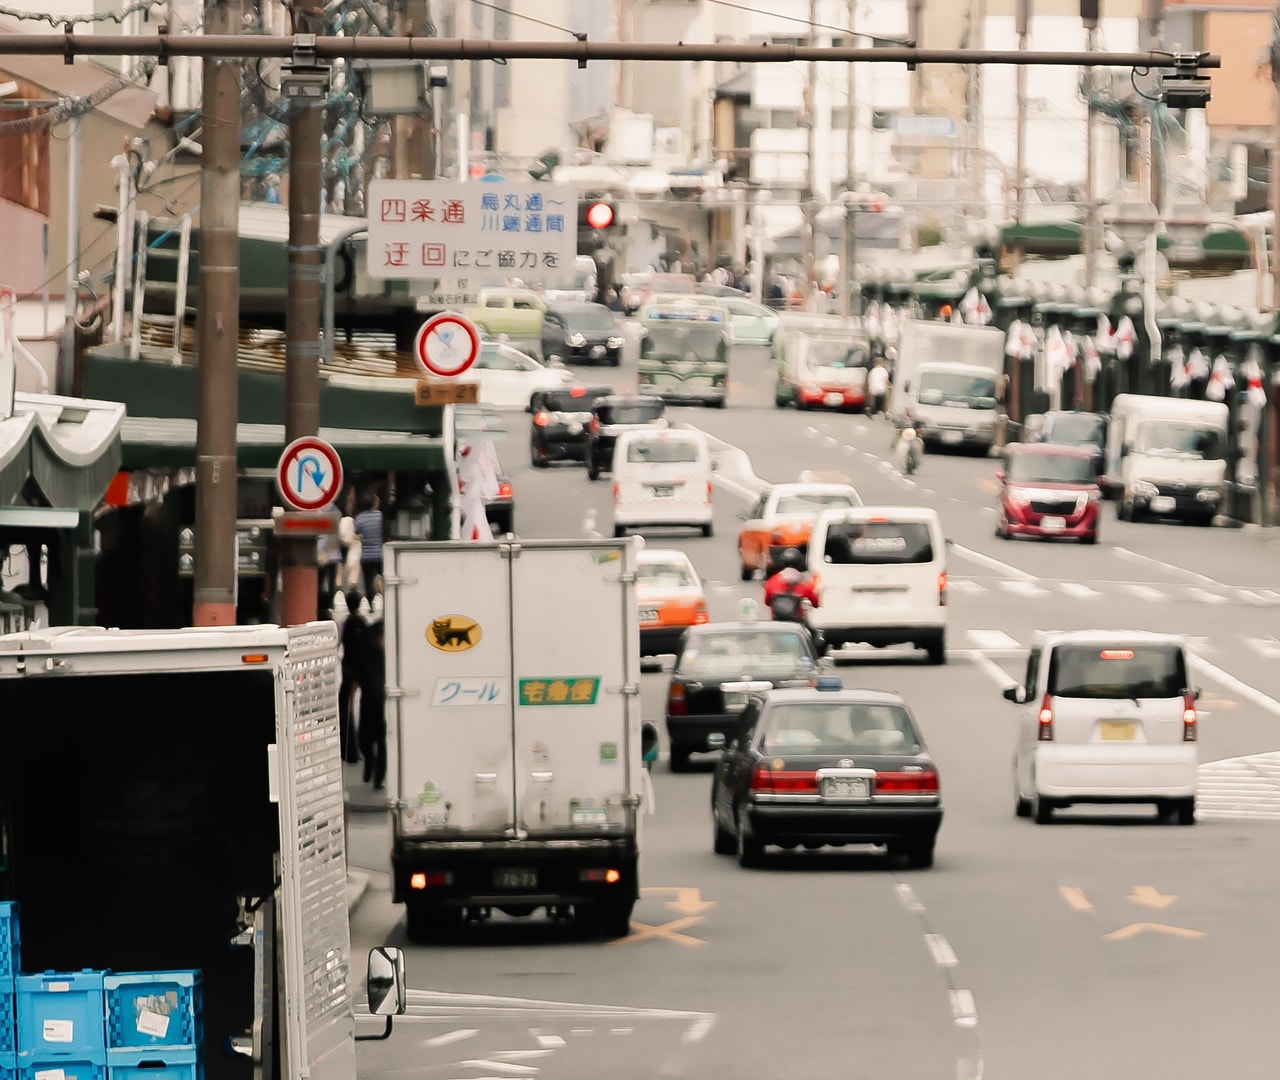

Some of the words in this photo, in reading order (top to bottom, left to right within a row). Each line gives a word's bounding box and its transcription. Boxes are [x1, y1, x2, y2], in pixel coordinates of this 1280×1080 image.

[381, 199, 465, 224] 四条通
[440, 681, 501, 703] クール
